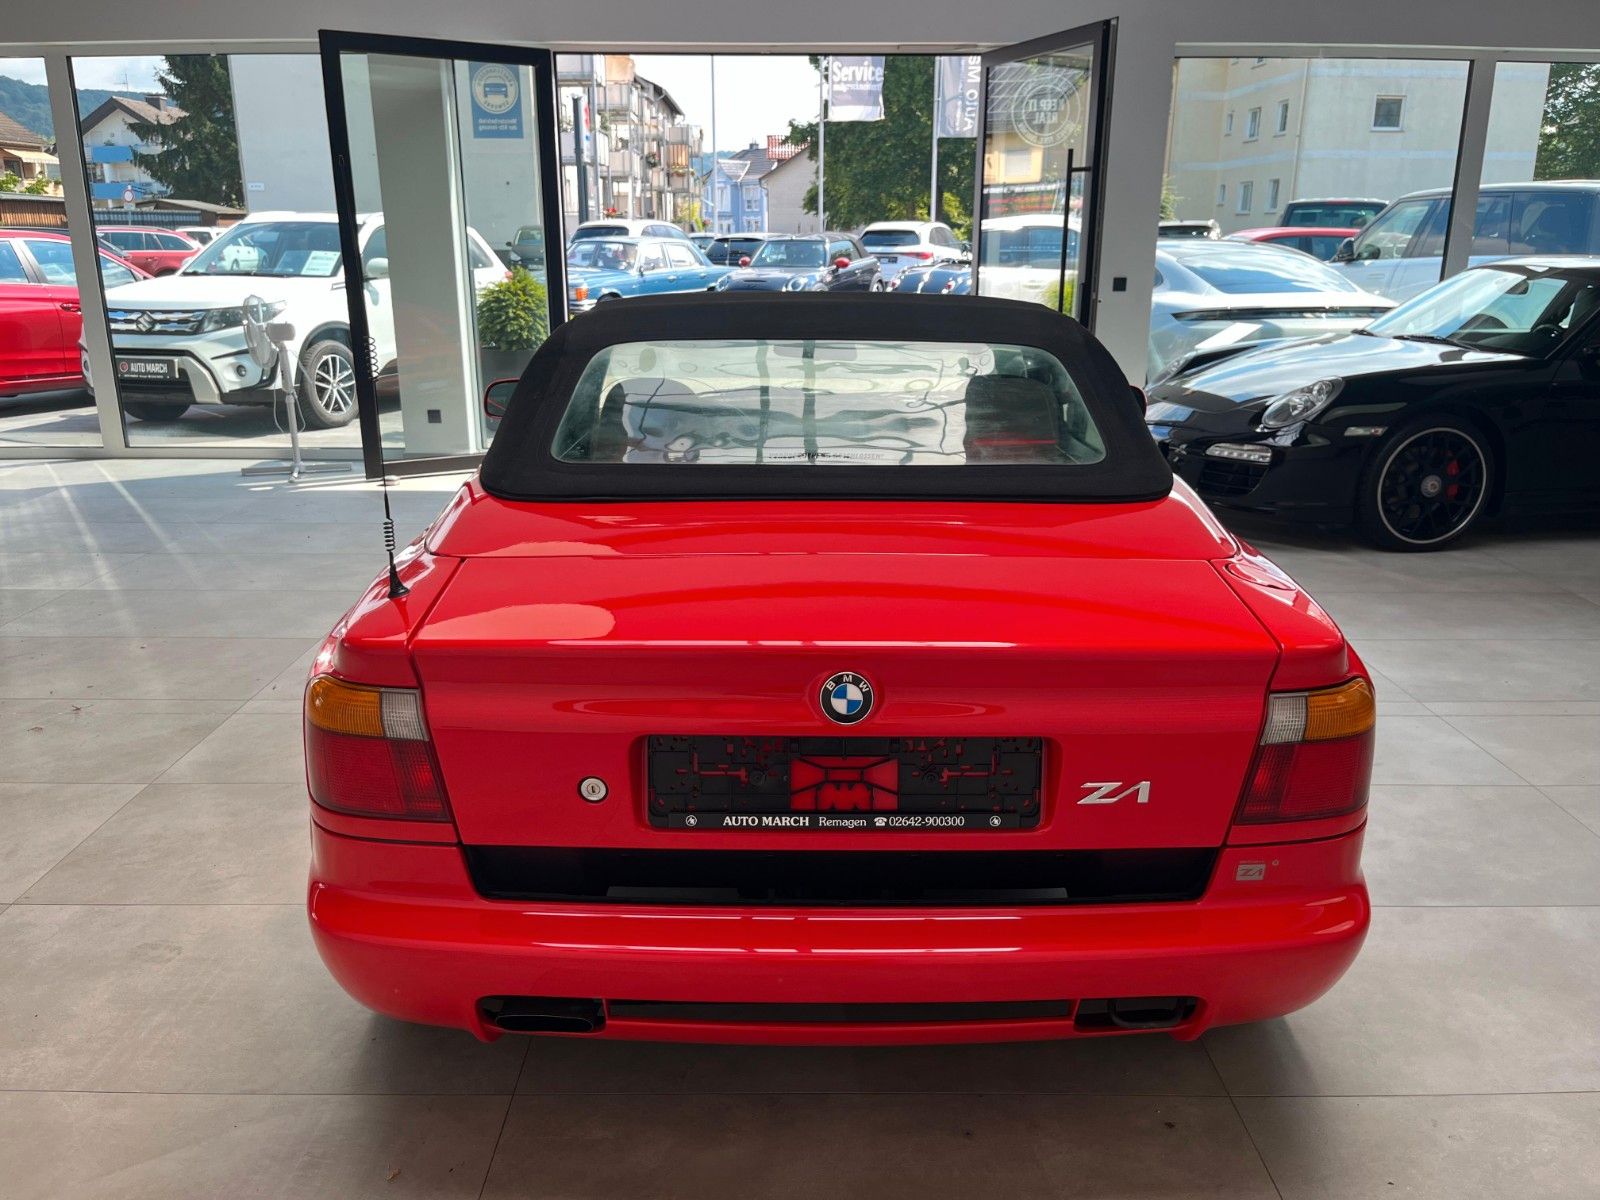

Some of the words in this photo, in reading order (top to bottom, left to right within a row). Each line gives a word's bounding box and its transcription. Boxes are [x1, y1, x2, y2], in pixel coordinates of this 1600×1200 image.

[832, 61, 884, 82] Service
[131, 362, 145, 373] AUTO
[146, 362, 168, 374] MARCH
[826, 674, 870, 692] BMW
[1077, 781, 1151, 805] Z1
[722, 815, 759, 827] AUTO
[761, 815, 810, 827] MARCH
[818, 816, 867, 829] Remagen
[888, 815, 965, 827] 02642-900300
